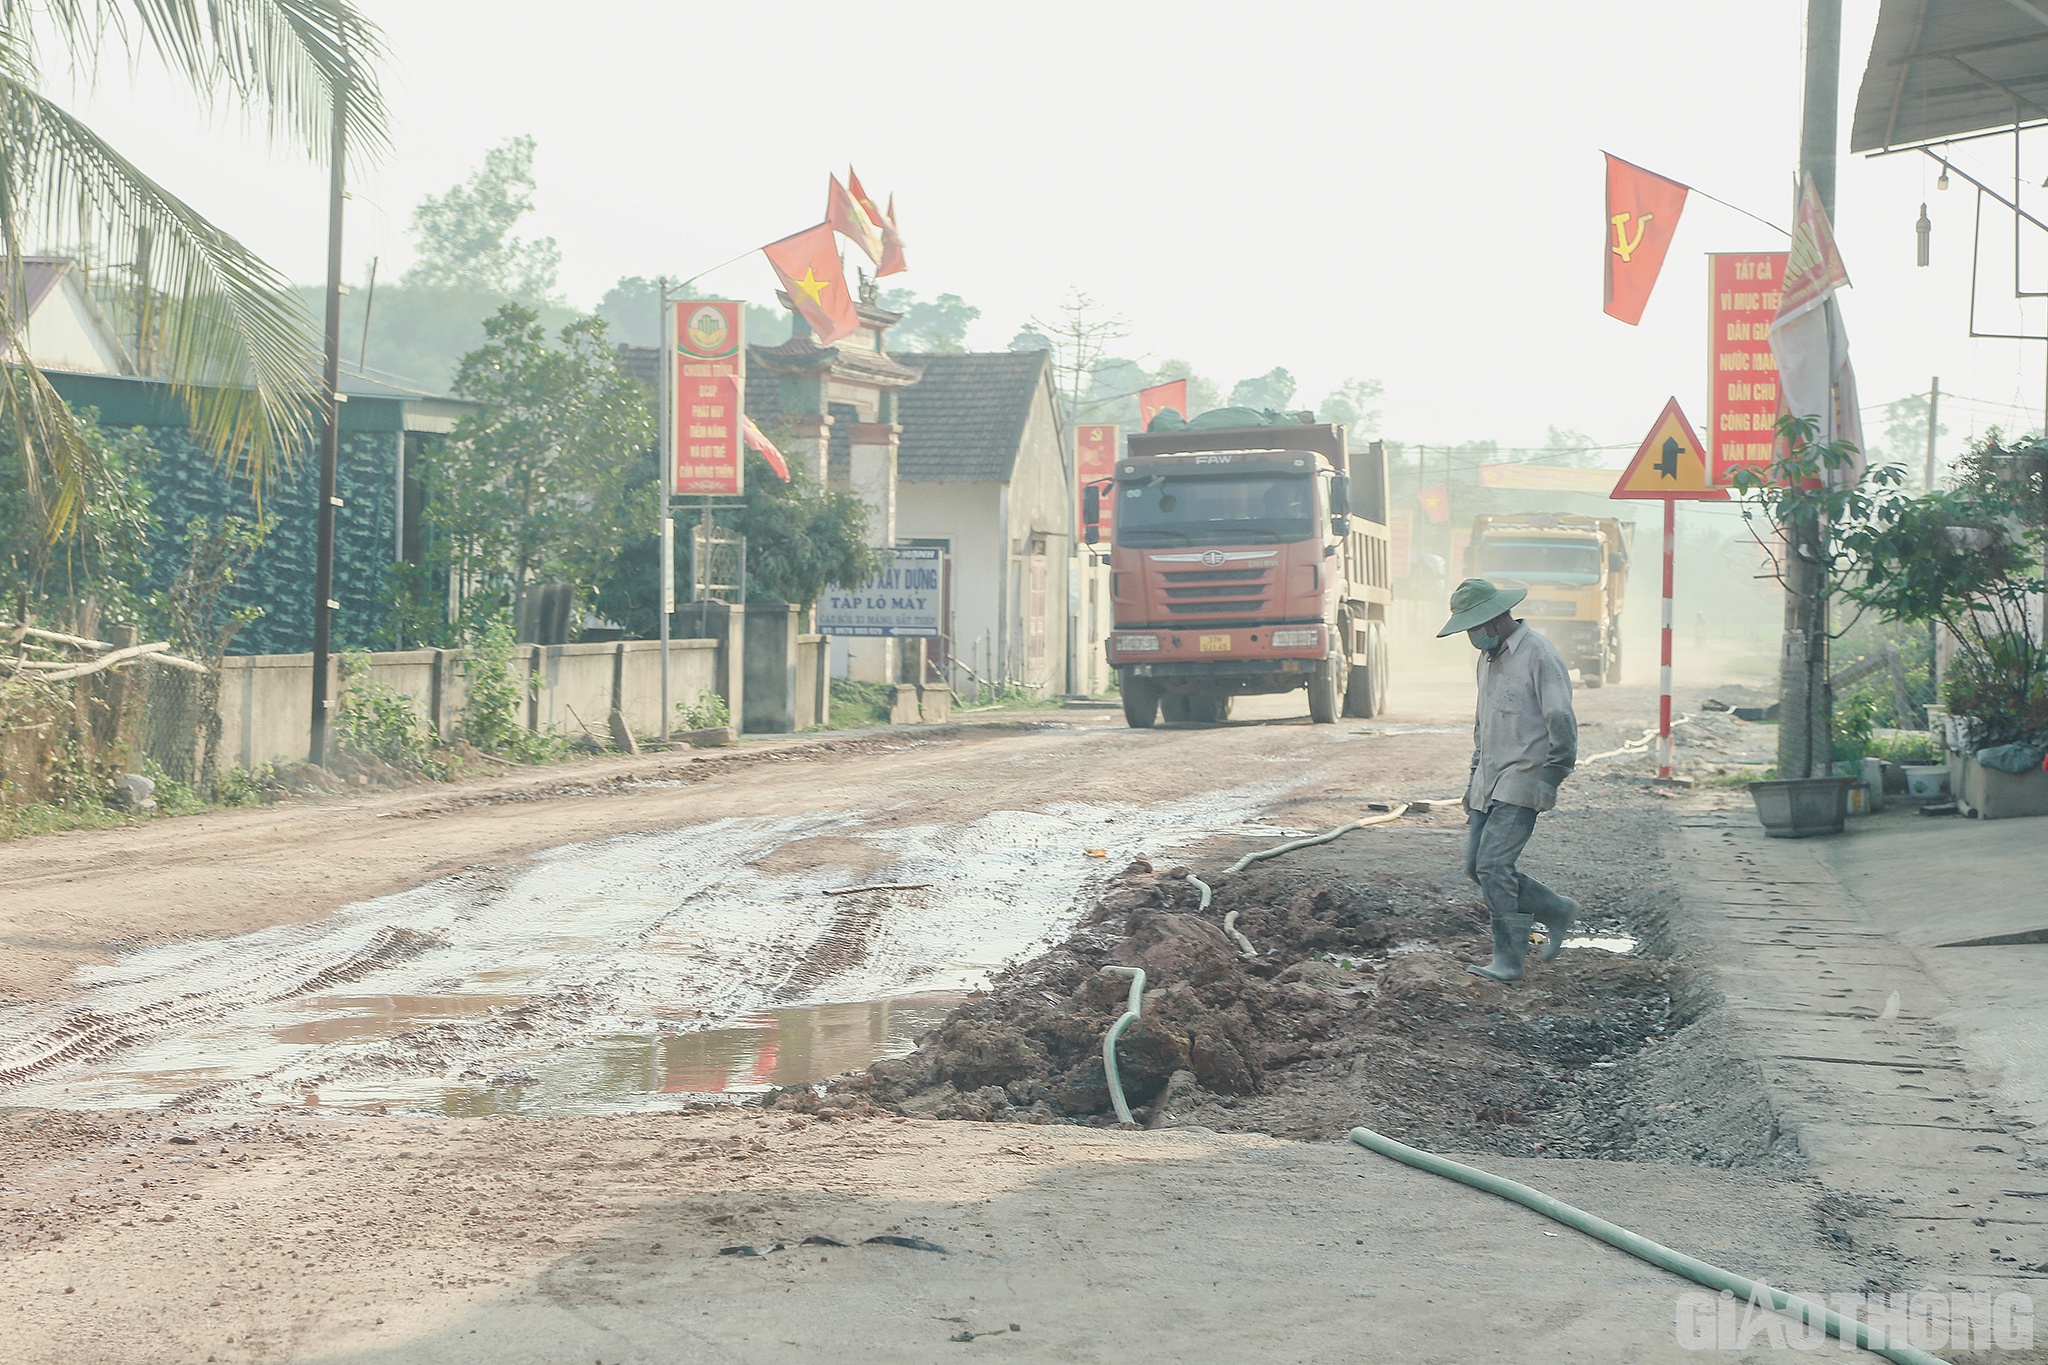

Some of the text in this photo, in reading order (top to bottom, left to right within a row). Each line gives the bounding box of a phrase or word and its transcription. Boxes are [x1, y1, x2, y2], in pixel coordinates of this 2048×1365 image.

[1735, 256, 1772, 280] TẤT CẢ
[1721, 289, 1732, 310] VÌ
[1734, 292, 1760, 314] MỤC
[1727, 319, 1771, 341] DÂN GIÀ
[1720, 349, 1778, 374] NƯỚC MẠN
[1728, 377, 1776, 401] DÂN CHỦ
[1720, 406, 1776, 431] CÔNG BẰN
[1195, 455, 1232, 464] FAW
[1722, 439, 1744, 461] VĂN
[904, 567, 937, 594] DỰNG
